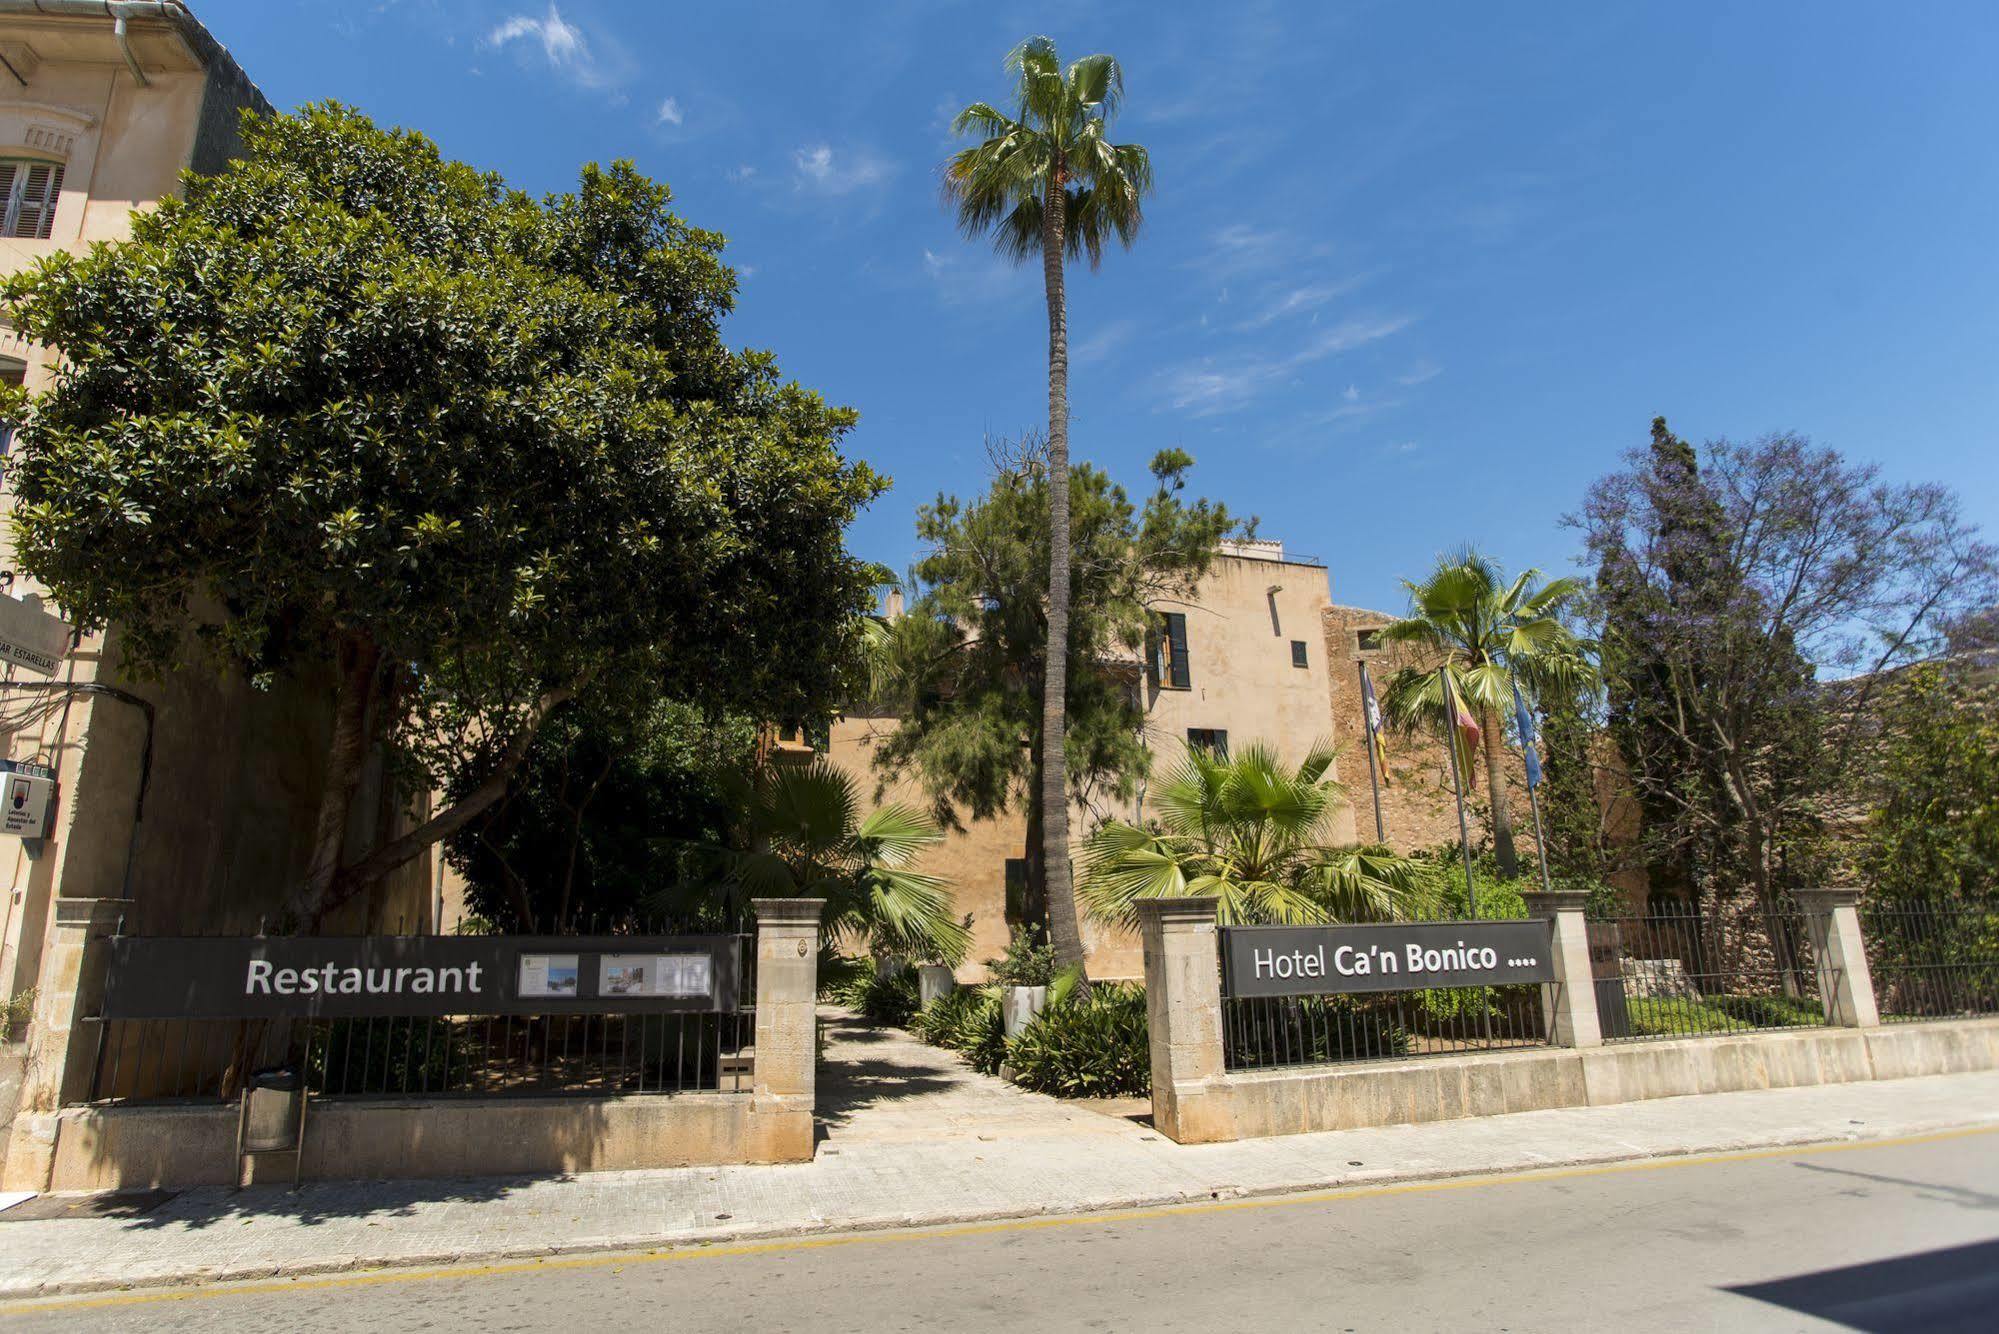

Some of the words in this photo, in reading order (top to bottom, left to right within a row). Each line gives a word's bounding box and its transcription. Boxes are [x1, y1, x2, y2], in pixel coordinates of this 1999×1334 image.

[0, 642, 11, 654] AR
[14, 648, 55, 670] ESTARELLAS
[245, 960, 483, 994] Restaurant
[1254, 945, 1325, 979] Hotel
[1334, 945, 1398, 976] Ca'n
[1406, 941, 1497, 973] Bonico
